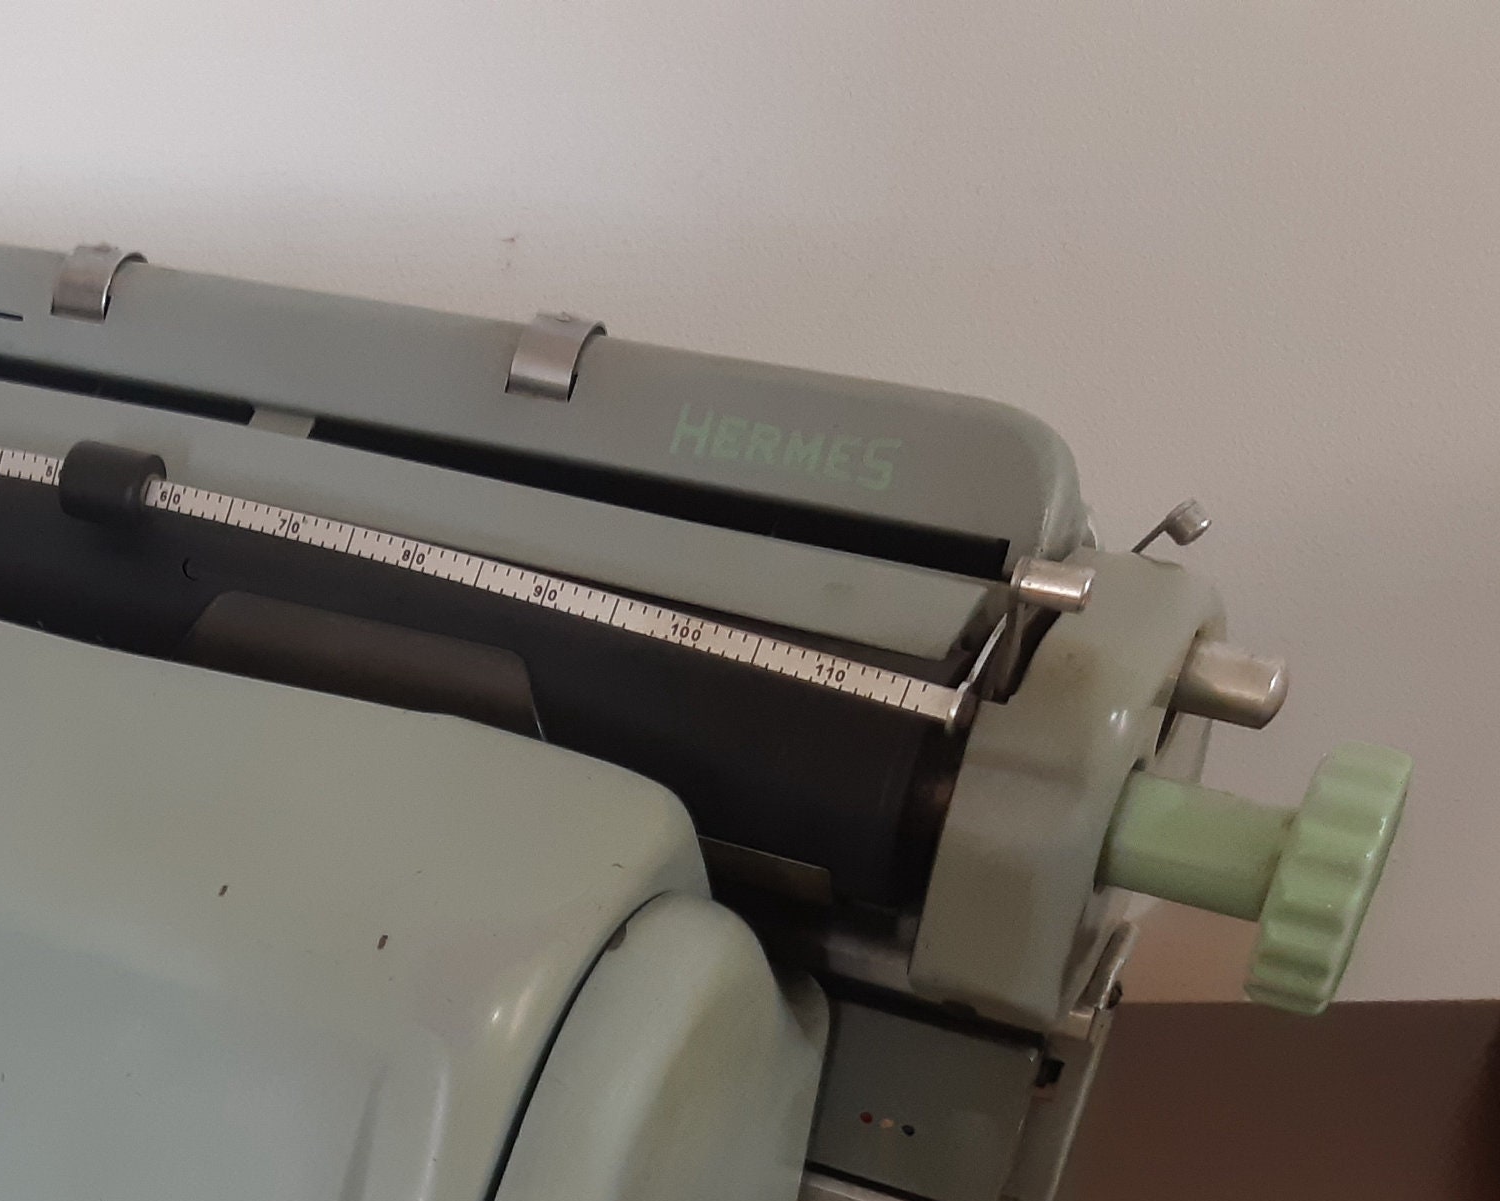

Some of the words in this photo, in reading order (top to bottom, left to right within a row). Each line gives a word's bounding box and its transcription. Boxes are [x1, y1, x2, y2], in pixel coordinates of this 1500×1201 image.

[669, 403, 905, 491] HERMES
[160, 490, 181, 506] 60
[277, 518, 300, 534] 70
[401, 549, 426, 566] 80
[533, 585, 558, 602] 90
[671, 623, 701, 642] 100
[815, 664, 846, 683] 110
